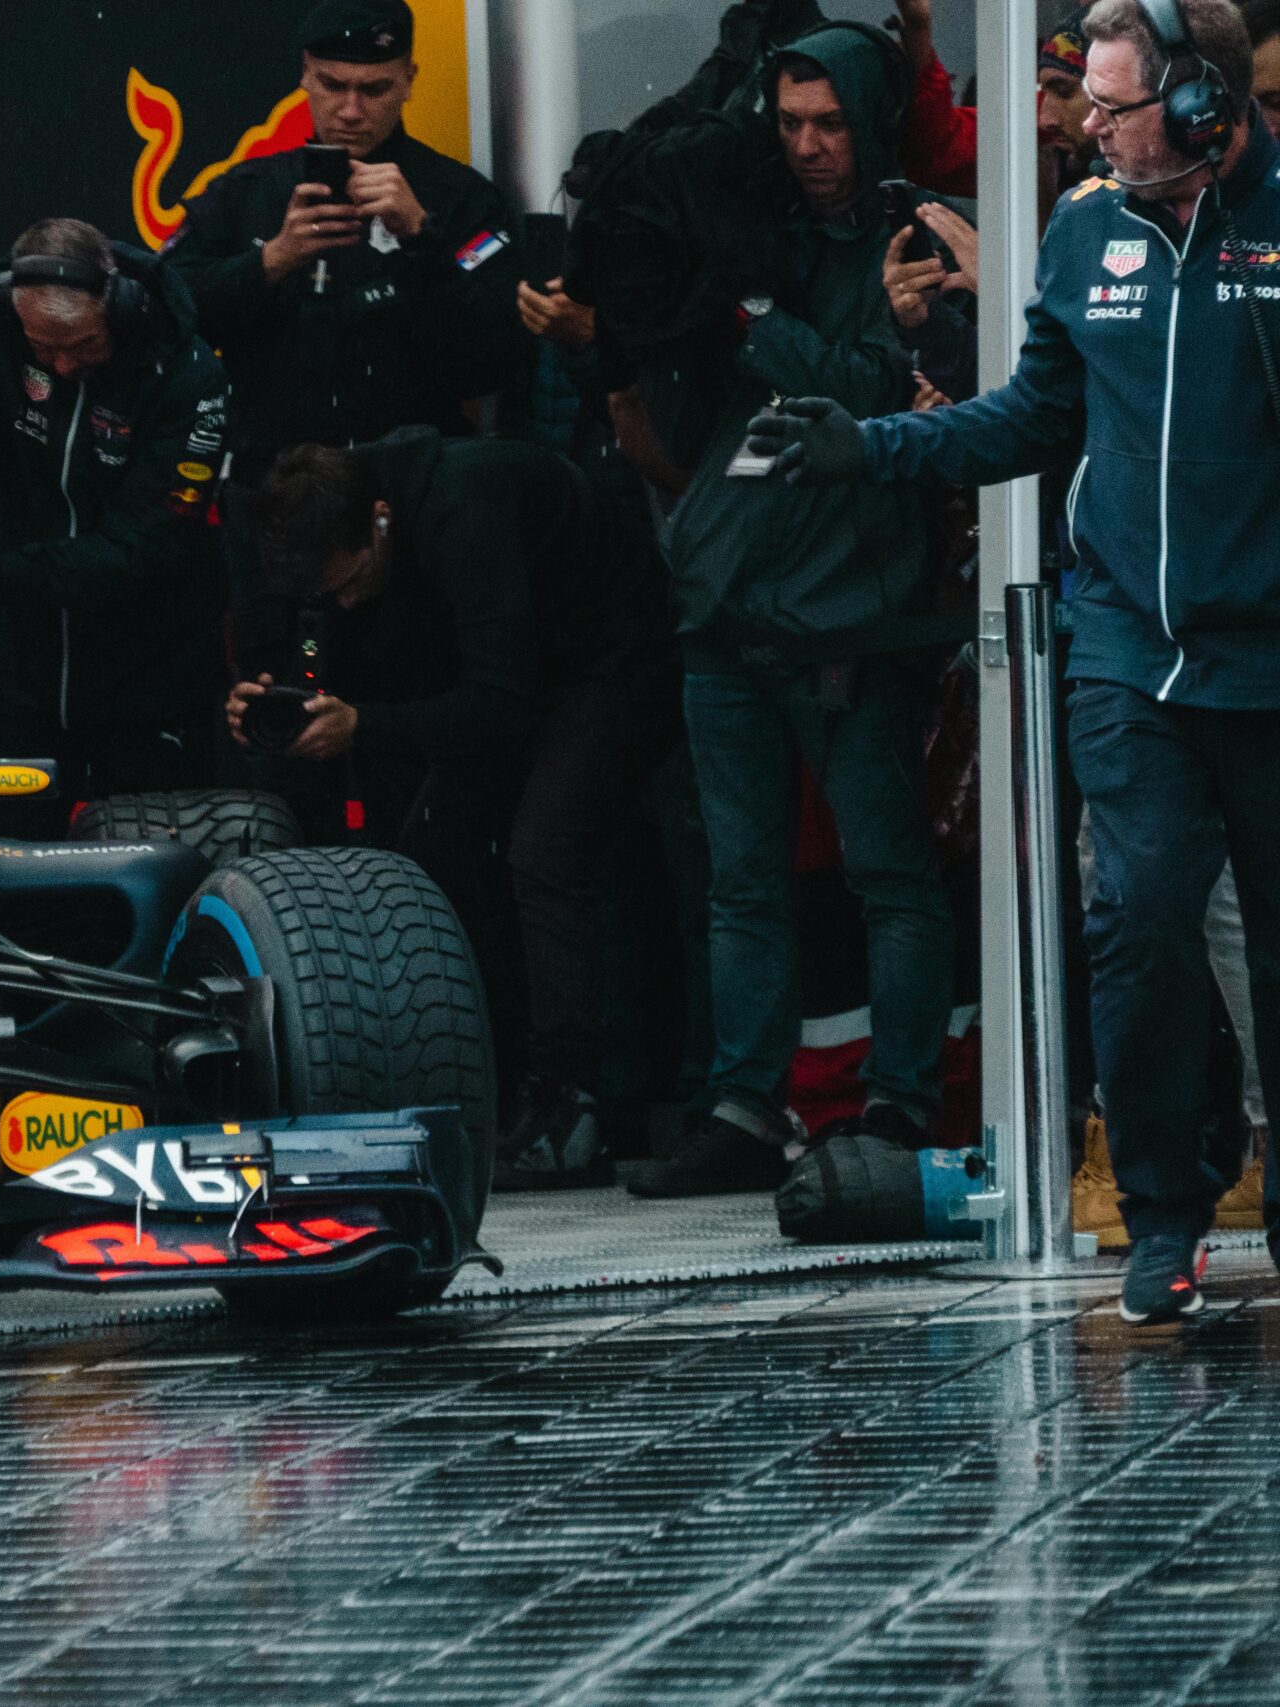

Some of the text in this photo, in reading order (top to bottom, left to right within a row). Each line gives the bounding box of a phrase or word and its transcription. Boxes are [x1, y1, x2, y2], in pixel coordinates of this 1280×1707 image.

[1111, 243, 1144, 254] TAG
[1088, 285, 1131, 303] Mobil
[1085, 307, 1143, 320] ORACLE
[26, 1108, 122, 1151] RAUCH
